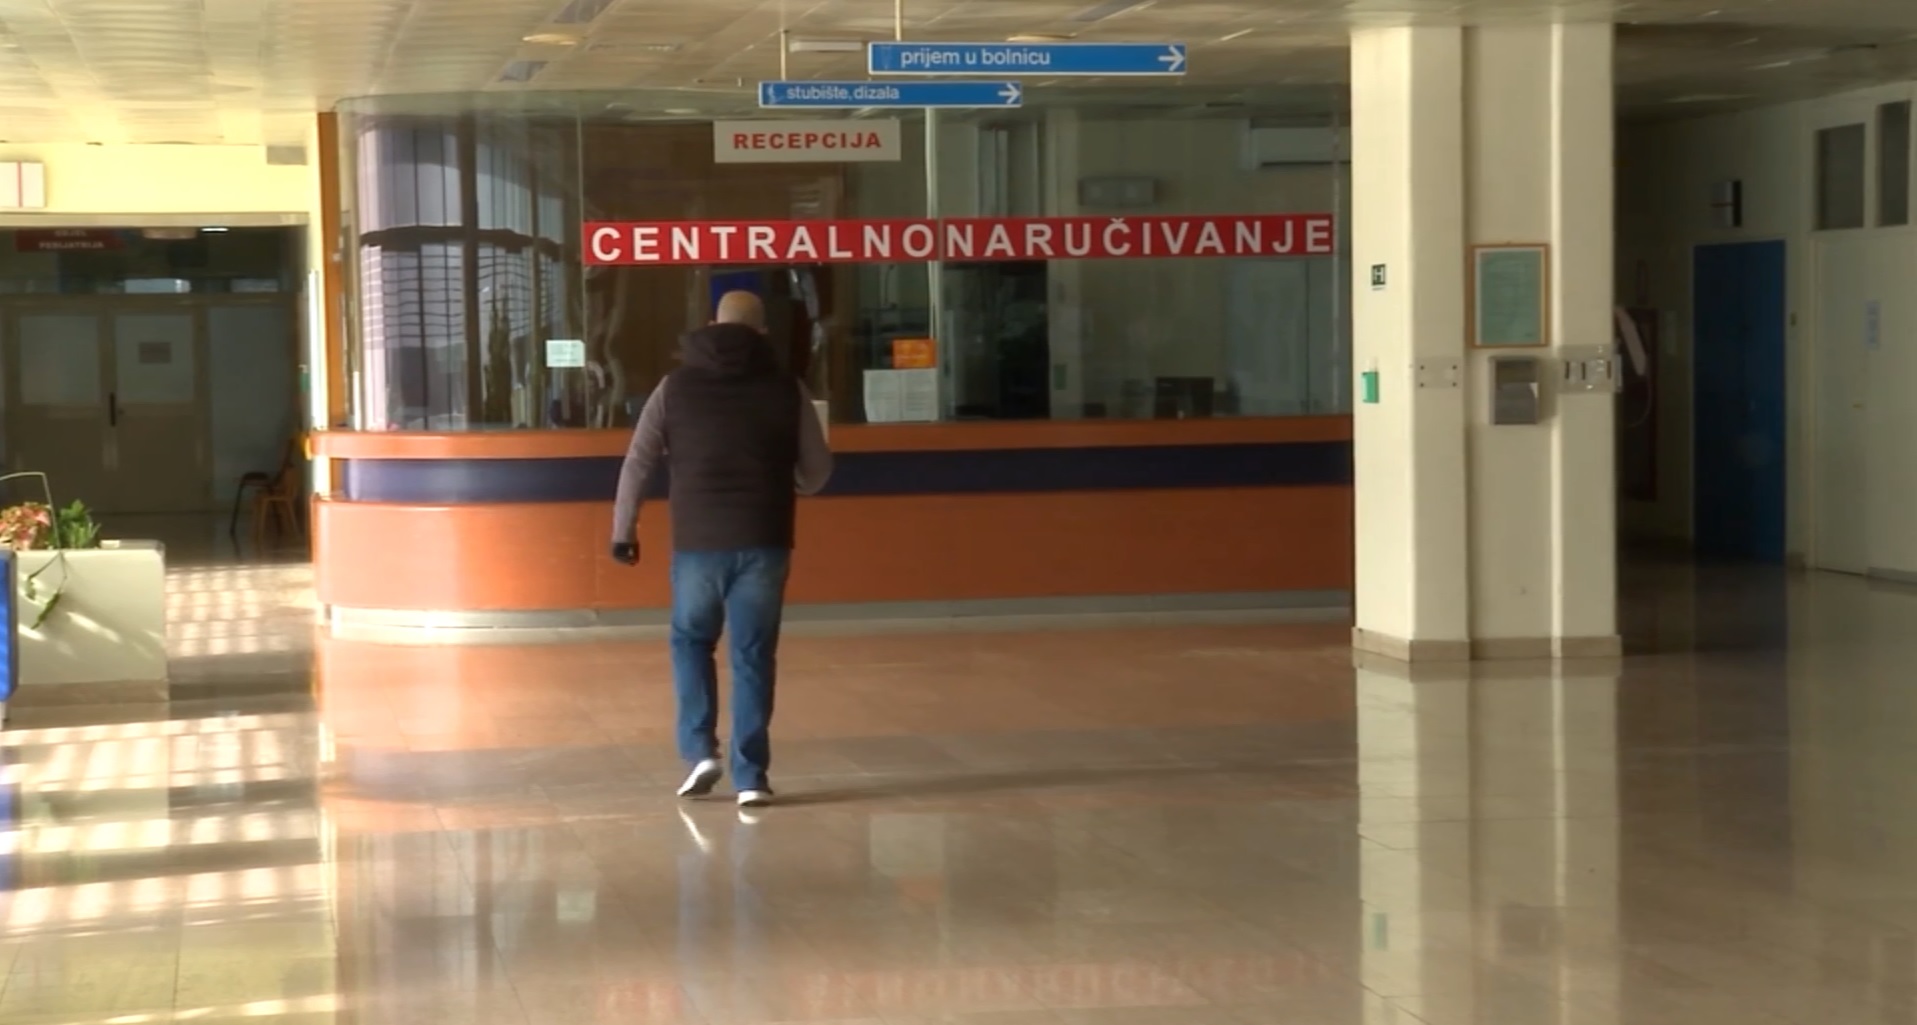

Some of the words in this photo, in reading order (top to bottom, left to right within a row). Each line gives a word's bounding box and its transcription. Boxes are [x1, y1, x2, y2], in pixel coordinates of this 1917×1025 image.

[901, 47, 960, 68] prijem
[965, 51, 976, 65] u
[981, 47, 1050, 65] bolnicu
[733, 131, 882, 150] RECEPCIJA
[591, 224, 935, 262] CENTRALNO
[946, 217, 1331, 257] NARUČIVANJE
